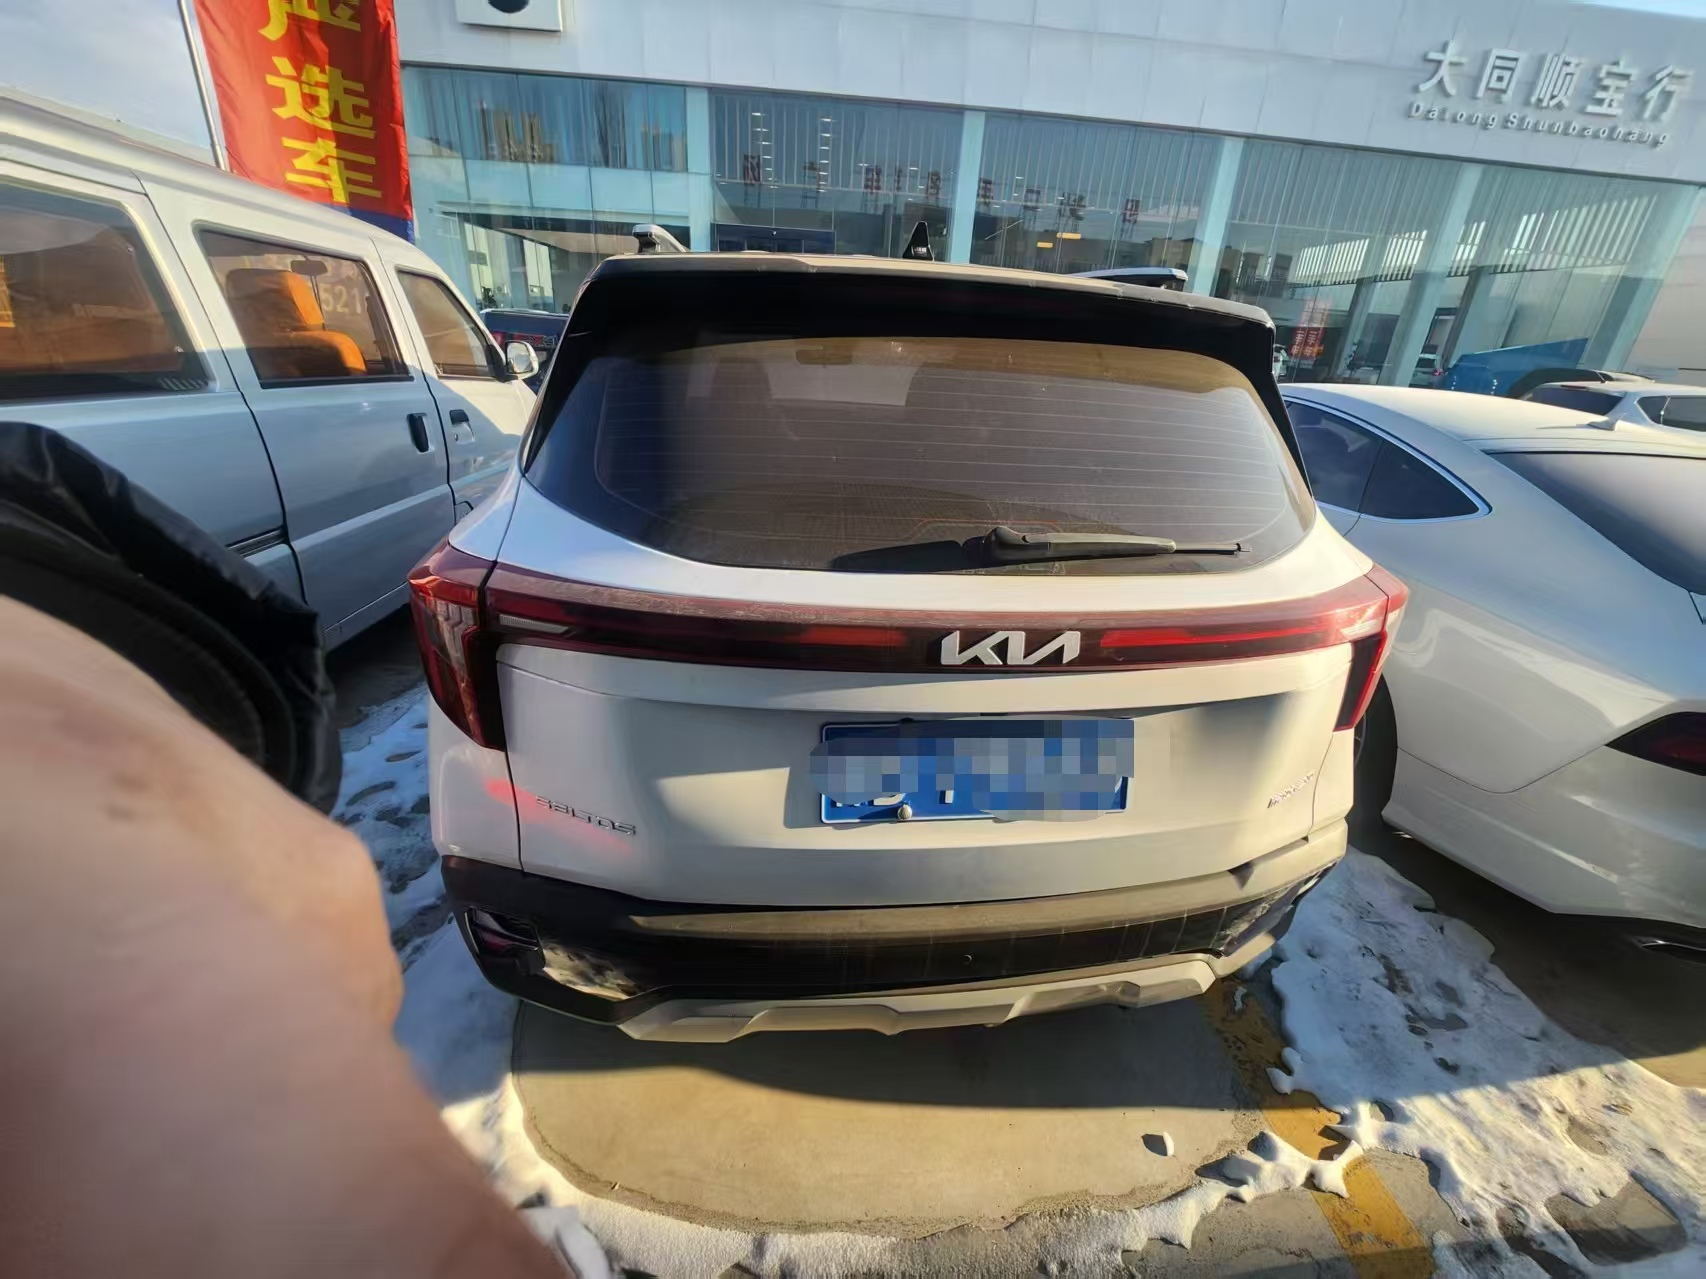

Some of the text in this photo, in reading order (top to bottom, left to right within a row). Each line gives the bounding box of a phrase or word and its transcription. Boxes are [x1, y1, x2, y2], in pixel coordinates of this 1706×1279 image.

[1417, 39, 1694, 122] 大同顺宝行
[941, 630, 1081, 665] KIA
